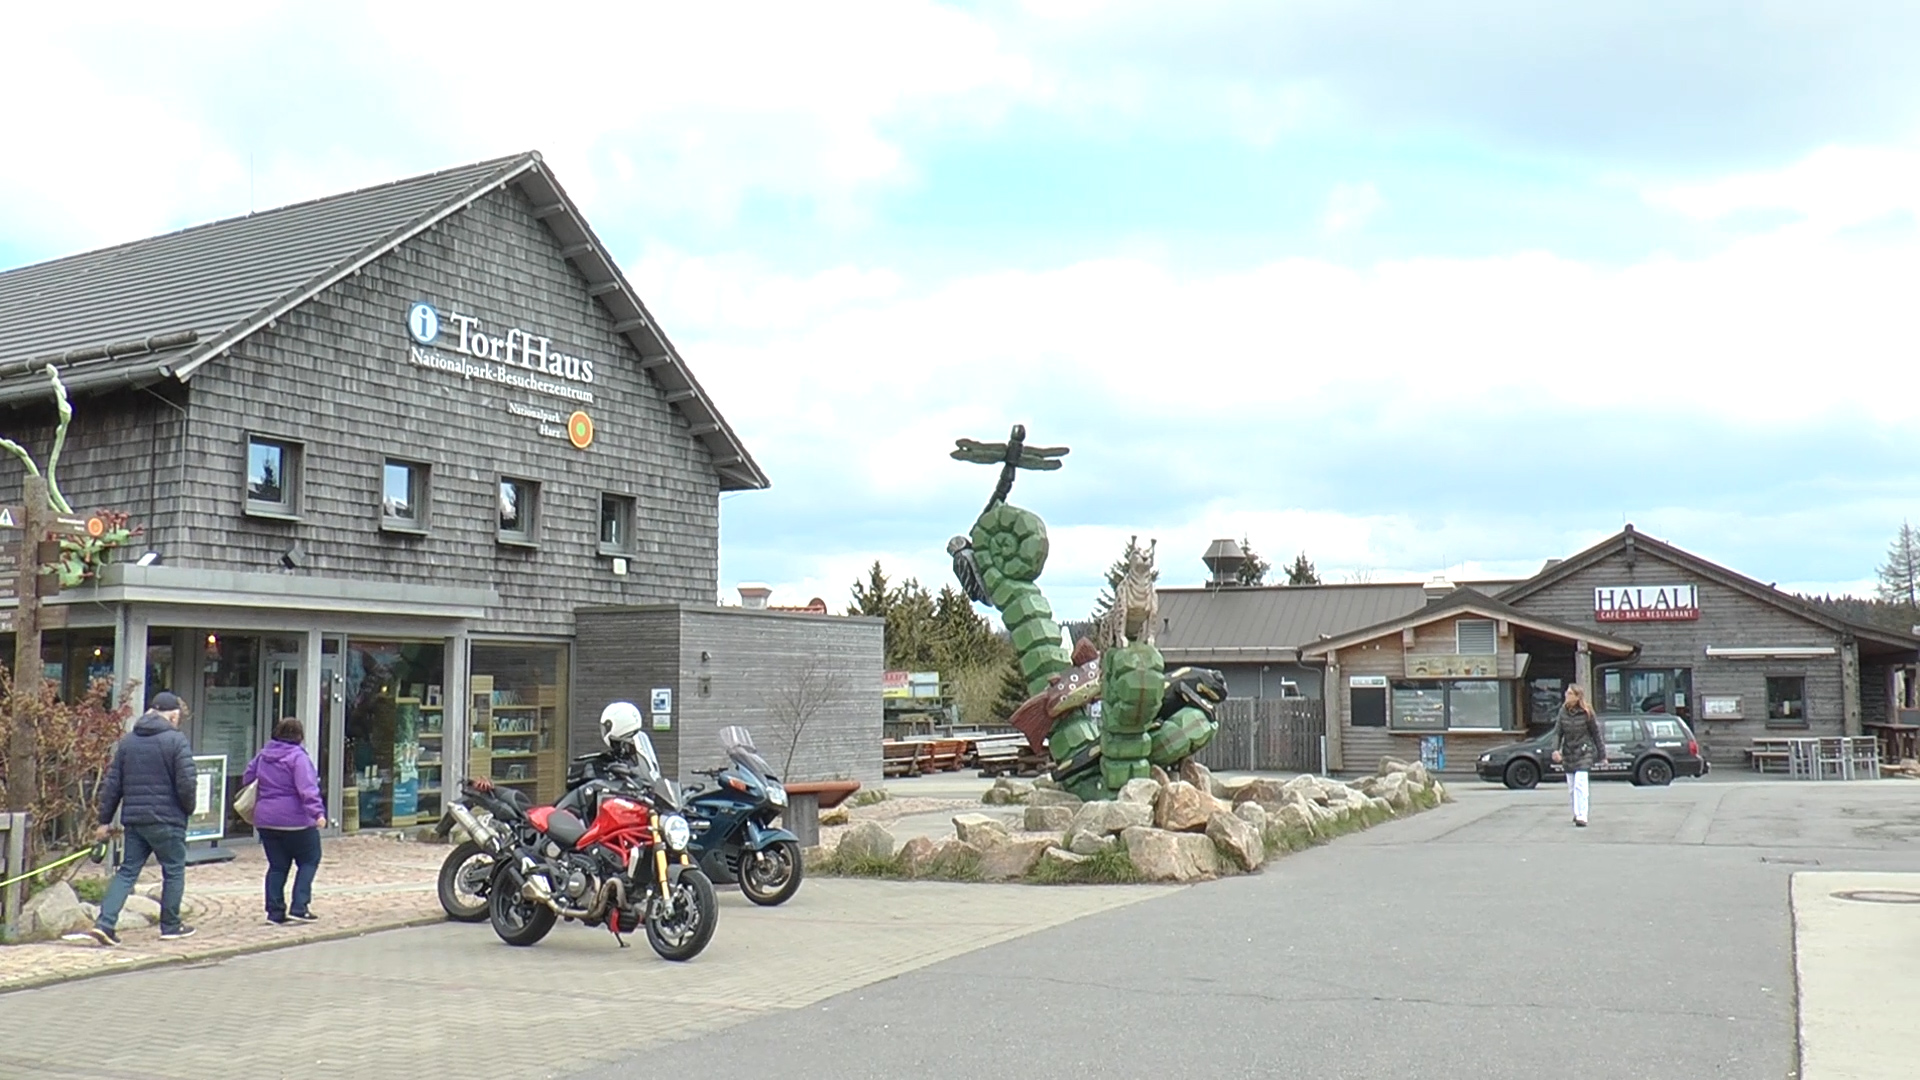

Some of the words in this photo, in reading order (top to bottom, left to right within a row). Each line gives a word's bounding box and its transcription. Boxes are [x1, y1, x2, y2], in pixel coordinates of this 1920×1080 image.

[450, 311, 594, 383] TorfHaus
[410, 346, 594, 403] Nationalpark-Besucherzentrum
[508, 402, 561, 424] Nationalpark
[540, 423, 561, 439] Harz
[1597, 584, 1696, 611] HALALI
[1625, 611, 1640, 619] BAR
[1646, 610, 1693, 619] RESTAURANT
